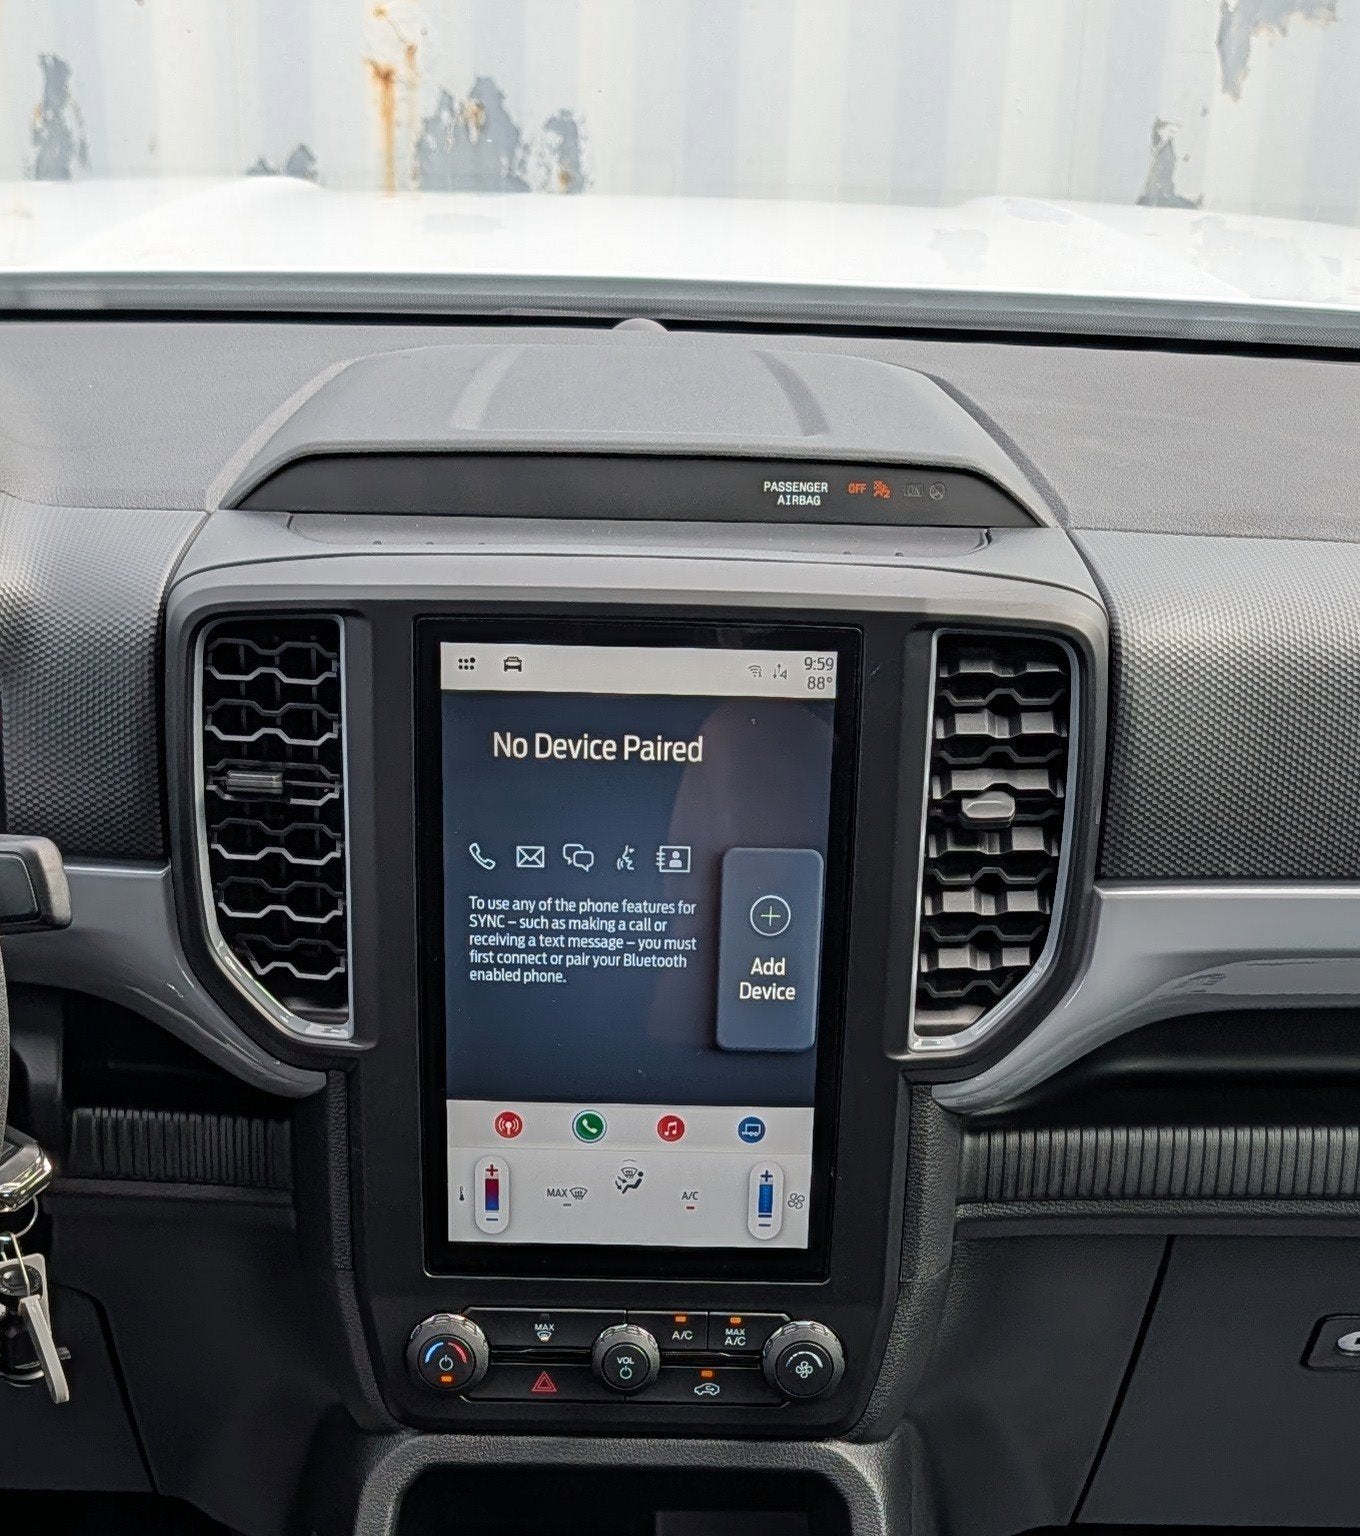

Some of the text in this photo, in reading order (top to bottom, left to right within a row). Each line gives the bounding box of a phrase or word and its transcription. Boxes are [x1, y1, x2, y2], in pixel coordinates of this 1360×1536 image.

[763, 481, 828, 493] PASSENGER
[848, 483, 867, 494] OFF
[777, 495, 821, 506] AIRBAG
[804, 656, 834, 671] 9:59
[493, 731, 704, 763] No Device Paired
[469, 896, 697, 915] To use any of the phone features for
[469, 914, 505, 928] SYNC
[519, 915, 549, 929] such
[551, 919, 566, 930] as
[568, 916, 616, 932] making
[618, 920, 627, 931] a
[629, 917, 651, 931] call
[653, 921, 667, 932] or
[469, 933, 525, 949] receiving
[528, 936, 536, 947] a
[539, 935, 566, 948] text
[568, 937, 623, 950] message
[637, 938, 661, 951] you
[664, 938, 697, 950] must
[469, 950, 687, 969] first connect or pair your Bluetooth
[750, 956, 786, 977] Add
[469, 968, 567, 984] enabled phone.
[739, 982, 796, 1001] Device
[546, 1188, 568, 1199] MAX
[681, 1191, 699, 1201] A/C
[534, 1323, 555, 1332] MAX
[725, 1328, 745, 1336] MAX
[672, 1330, 693, 1341] A/C
[725, 1336, 746, 1347] A/C
[616, 1356, 635, 1365] VOL
